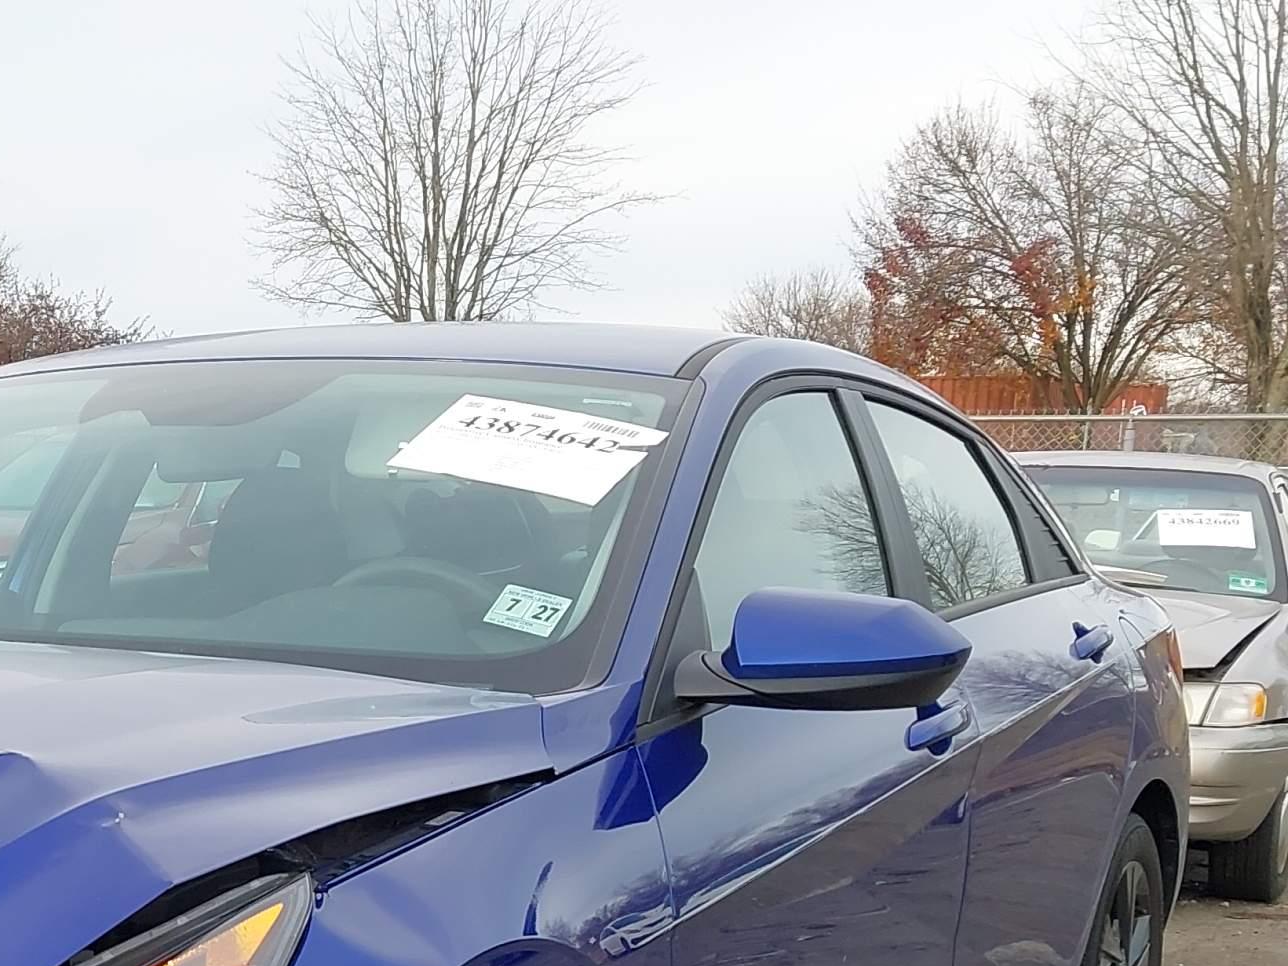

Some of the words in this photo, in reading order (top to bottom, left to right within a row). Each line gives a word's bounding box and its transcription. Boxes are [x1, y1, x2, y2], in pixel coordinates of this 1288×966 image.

[458, 414, 621, 454] 43874642
[506, 598, 522, 612] 7
[531, 604, 561, 623] 27
